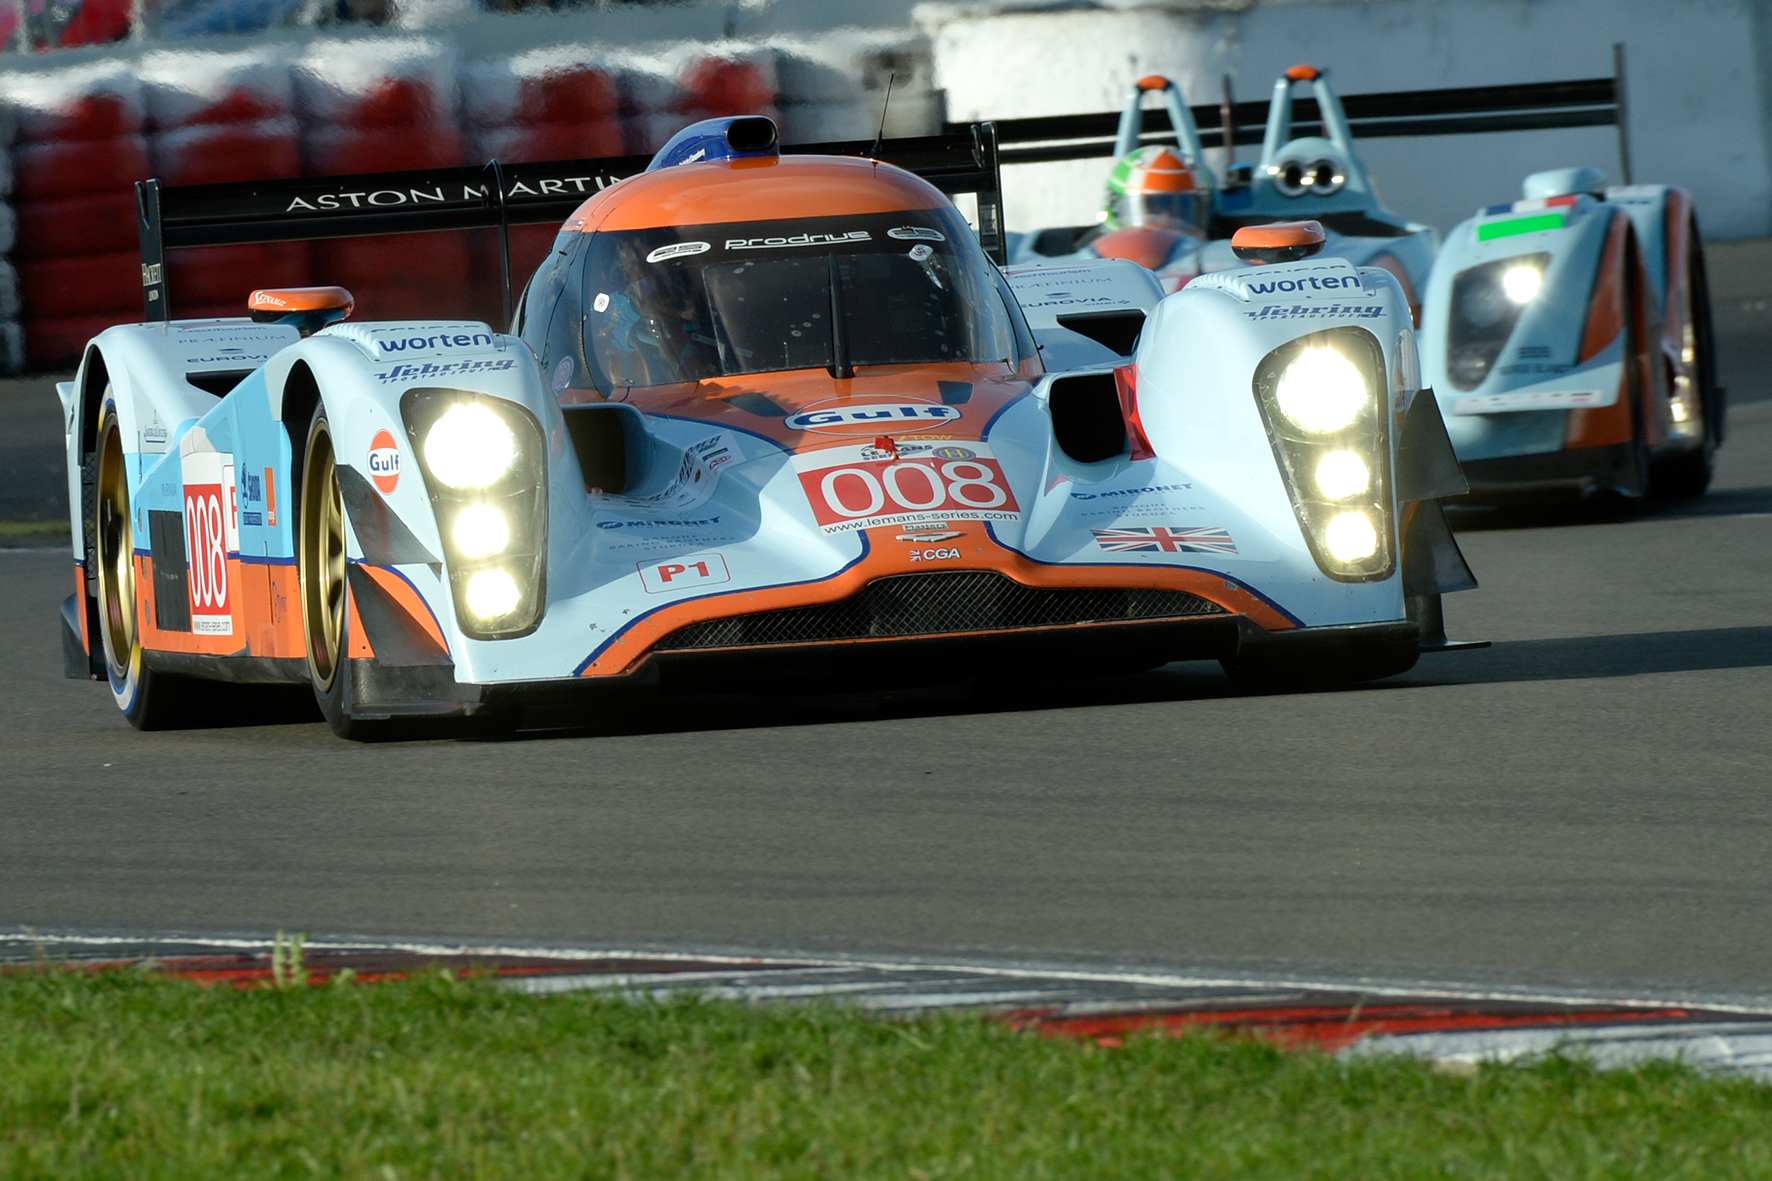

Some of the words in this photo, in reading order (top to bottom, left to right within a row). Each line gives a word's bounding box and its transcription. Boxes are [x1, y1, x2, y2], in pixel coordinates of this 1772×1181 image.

[287, 187, 445, 212] ASTON
[1248, 276, 1361, 295] worten
[1243, 304, 1387, 319] Sebring
[379, 334, 492, 352] worten
[187, 355, 268, 363] EUROVI
[373, 360, 518, 380] Sebring
[793, 407, 951, 426] Gulf
[370, 453, 399, 471] Gulf
[821, 461, 1007, 517] 008
[1100, 483, 1192, 498] MIRONET
[824, 510, 1019, 535] www.lemans-series.com
[186, 494, 227, 608] 008
[923, 547, 961, 561] CGA
[658, 561, 710, 583] P1
